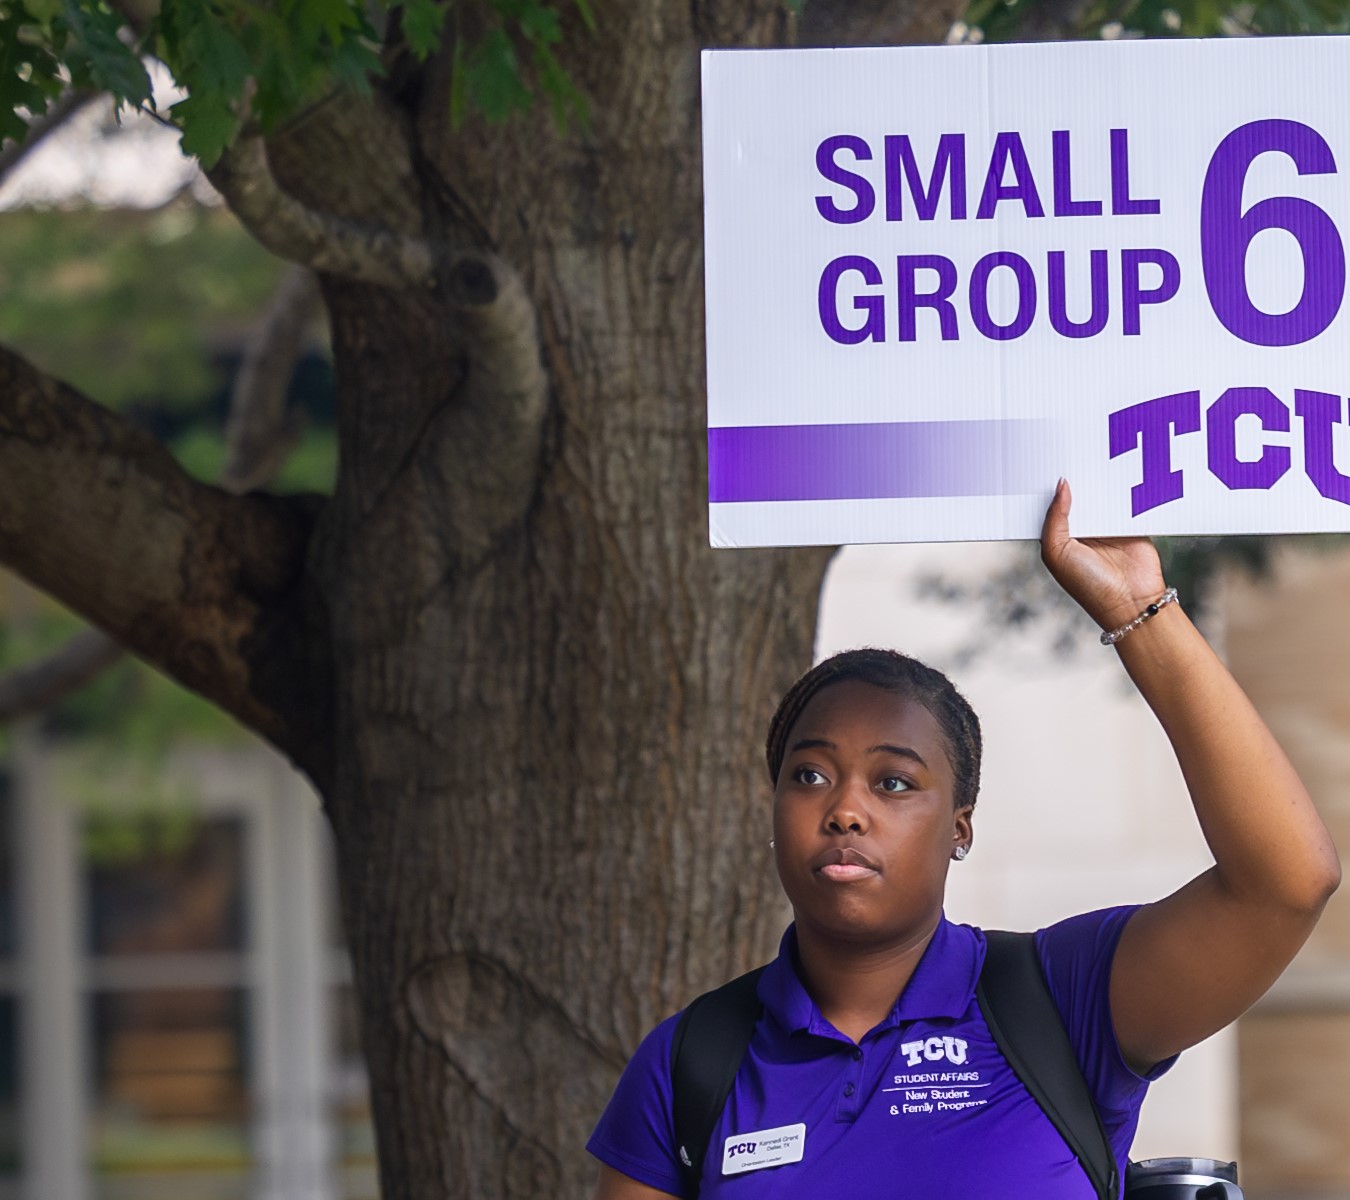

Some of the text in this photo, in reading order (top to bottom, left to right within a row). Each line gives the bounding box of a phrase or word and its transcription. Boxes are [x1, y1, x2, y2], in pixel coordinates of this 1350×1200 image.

[814, 129, 1161, 224] SMALL
[1200, 118, 1346, 347] 6
[817, 248, 1181, 345] GROUP
[901, 1036, 968, 1067] TCU
[894, 1071, 979, 1084] STUDENT AFFAIRS
[905, 1089, 970, 1101] New Student
[889, 1105, 899, 1115] &
[902, 1102, 934, 1114] Family
[728, 1142, 757, 1158] TCU
